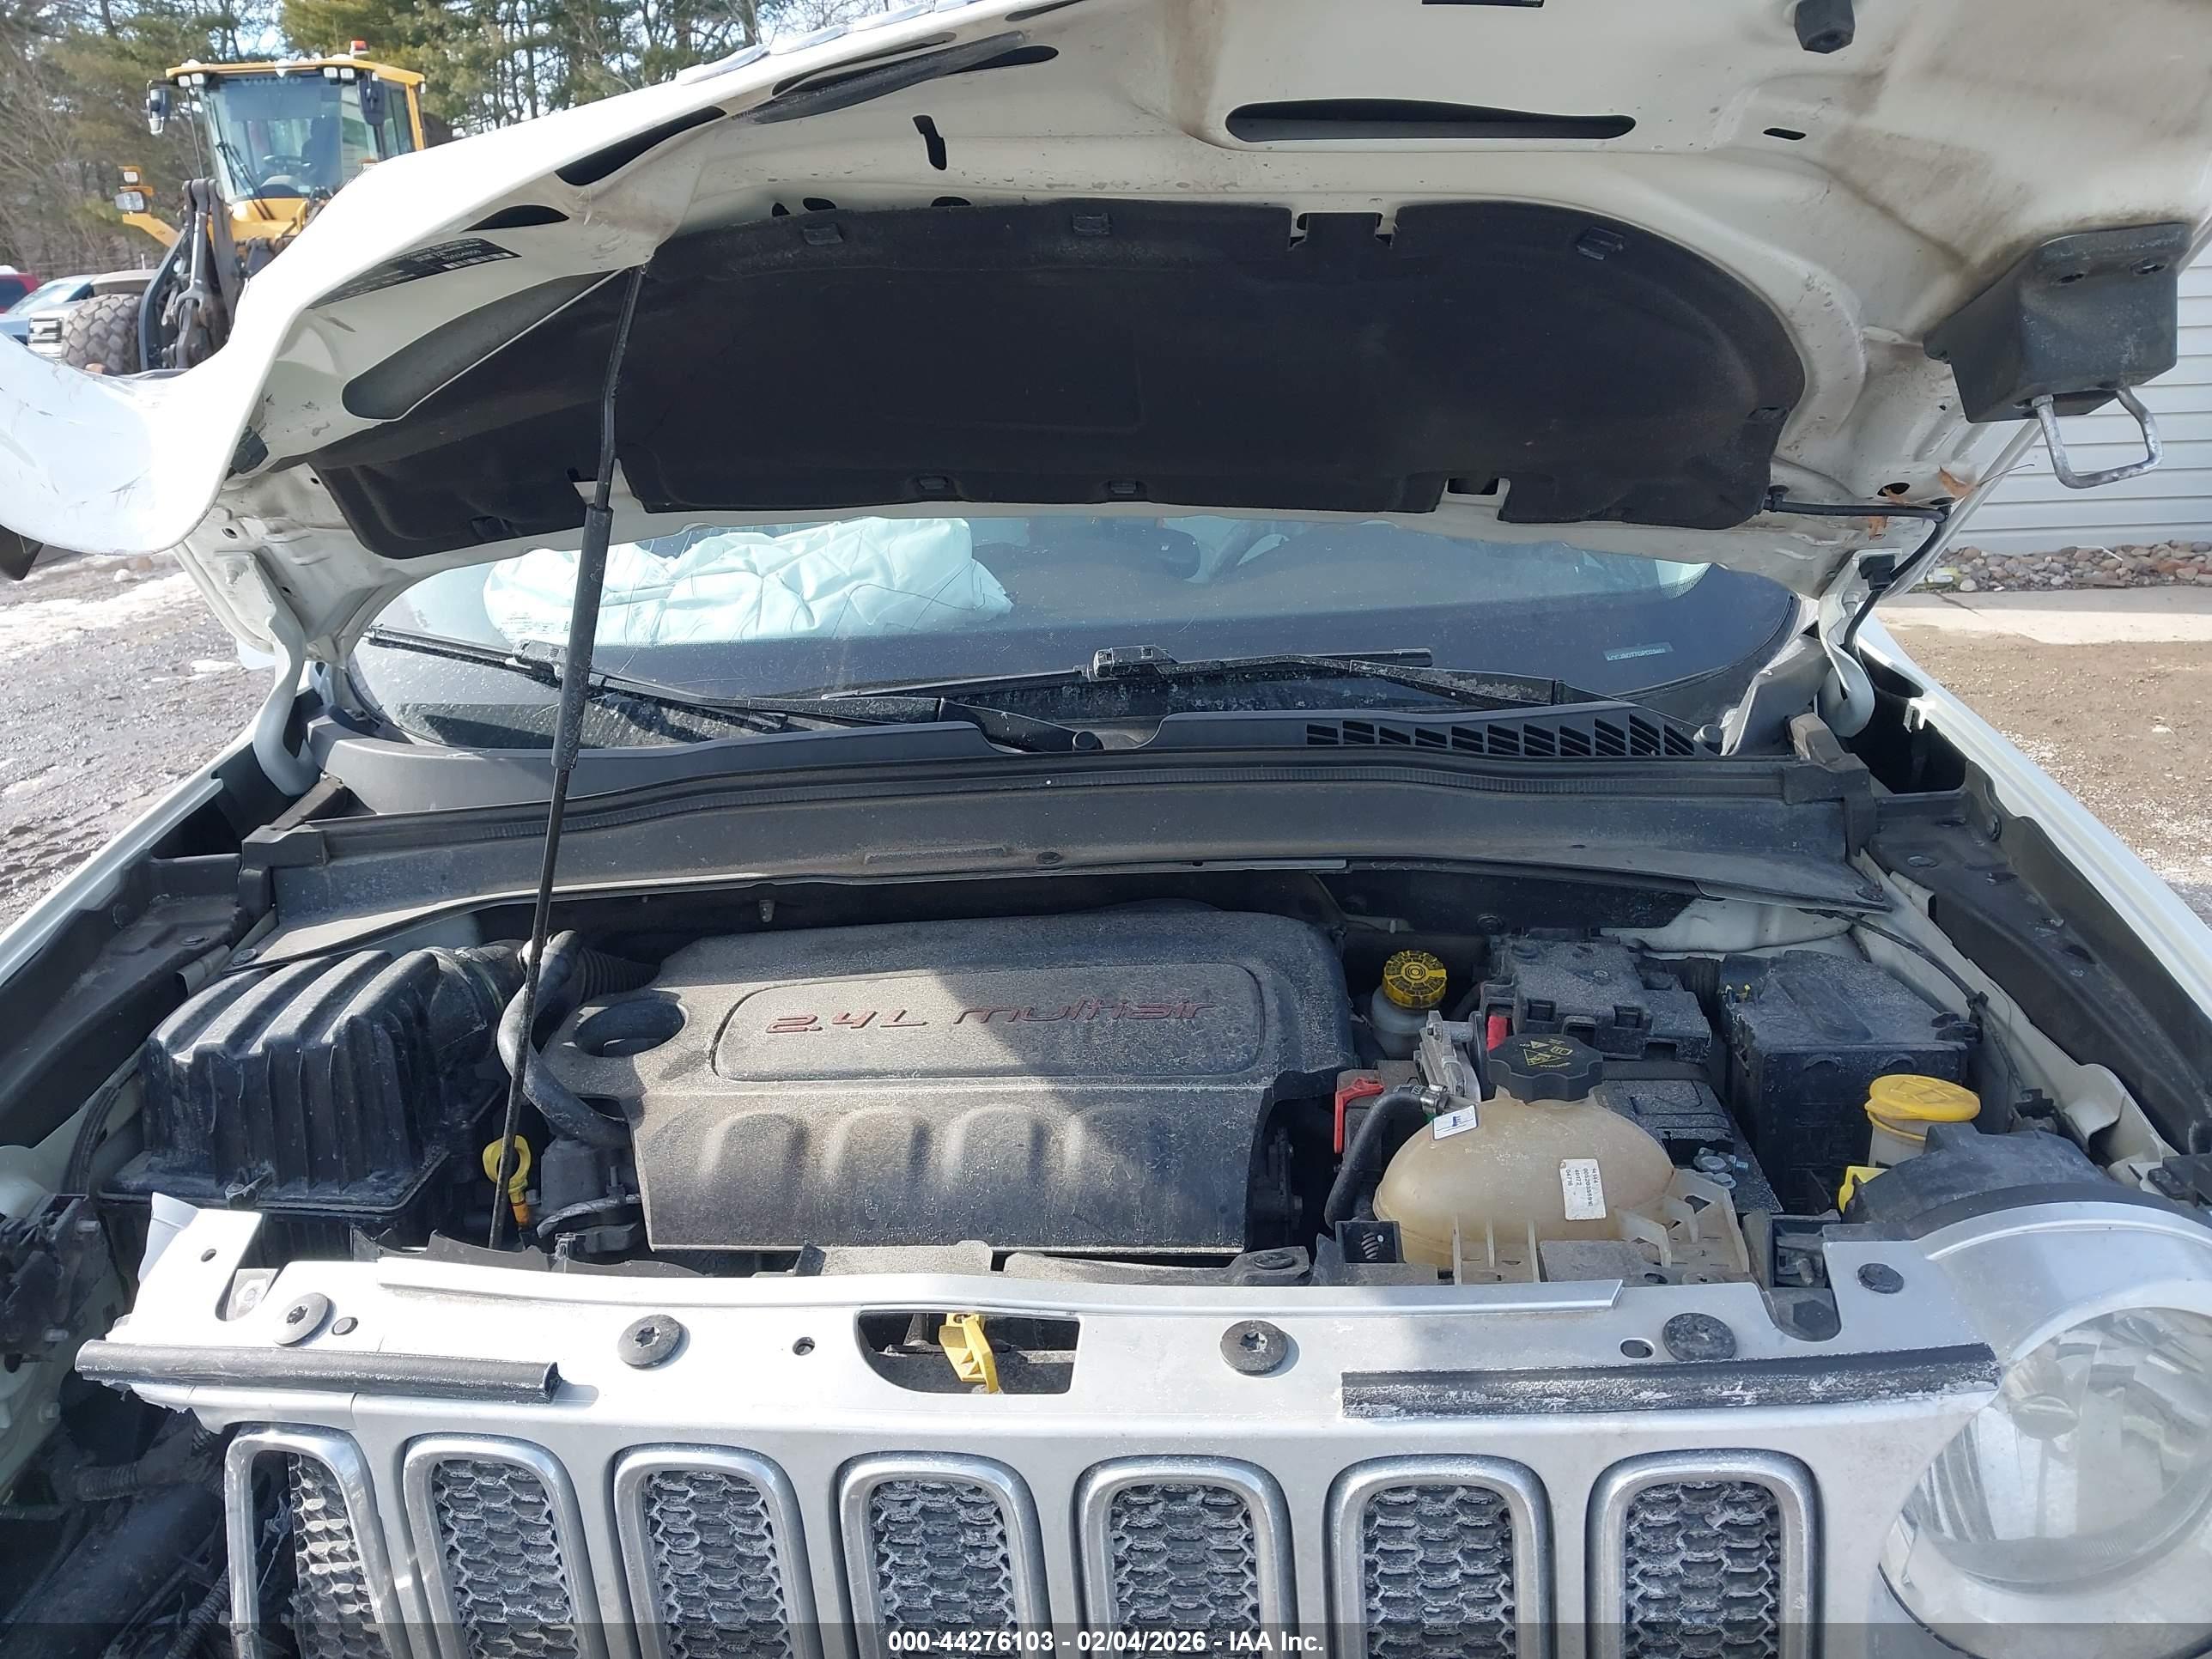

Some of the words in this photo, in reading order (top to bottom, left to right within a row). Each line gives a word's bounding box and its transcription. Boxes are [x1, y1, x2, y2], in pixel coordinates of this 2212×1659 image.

[240, 75, 302, 87] VOLVO
[766, 1010, 928, 1033] 2.4L
[953, 995, 1216, 1024] multiair
